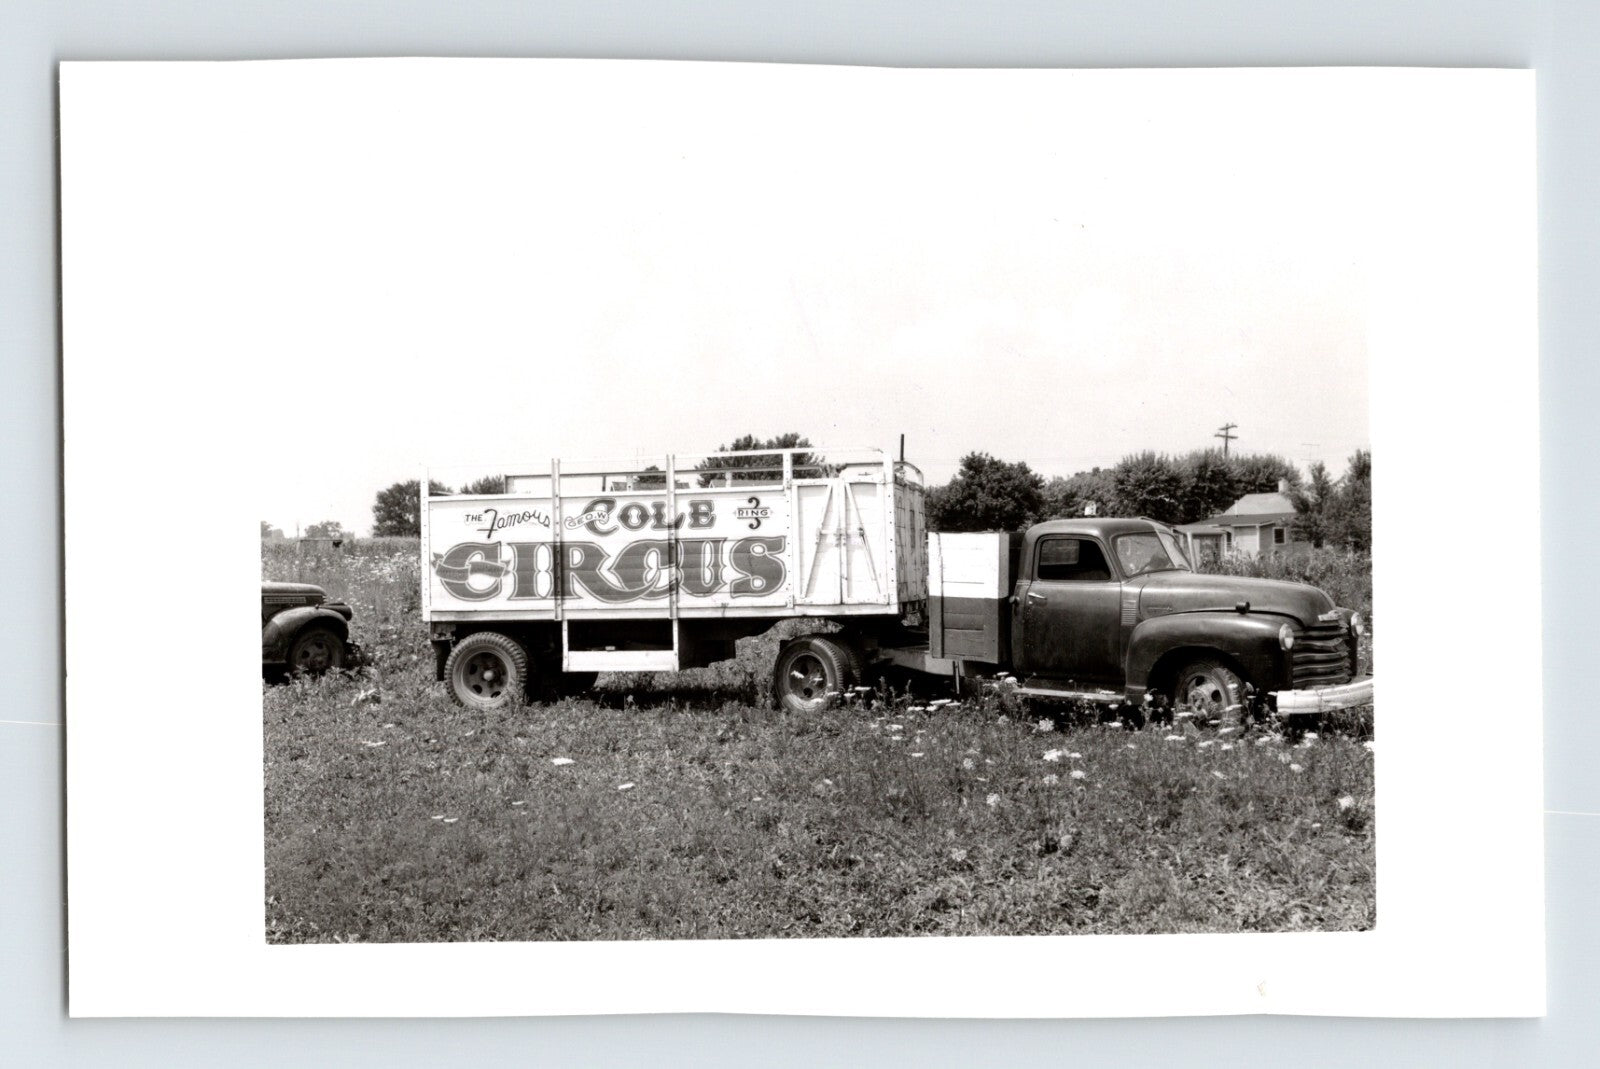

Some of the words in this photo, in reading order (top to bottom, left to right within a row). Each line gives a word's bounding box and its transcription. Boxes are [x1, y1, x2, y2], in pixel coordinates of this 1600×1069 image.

[465, 514, 483, 522] THE
[477, 508, 550, 539] Famous
[582, 498, 717, 536] COLE
[737, 508, 769, 517] RING
[440, 536, 787, 604] CIRCUS
